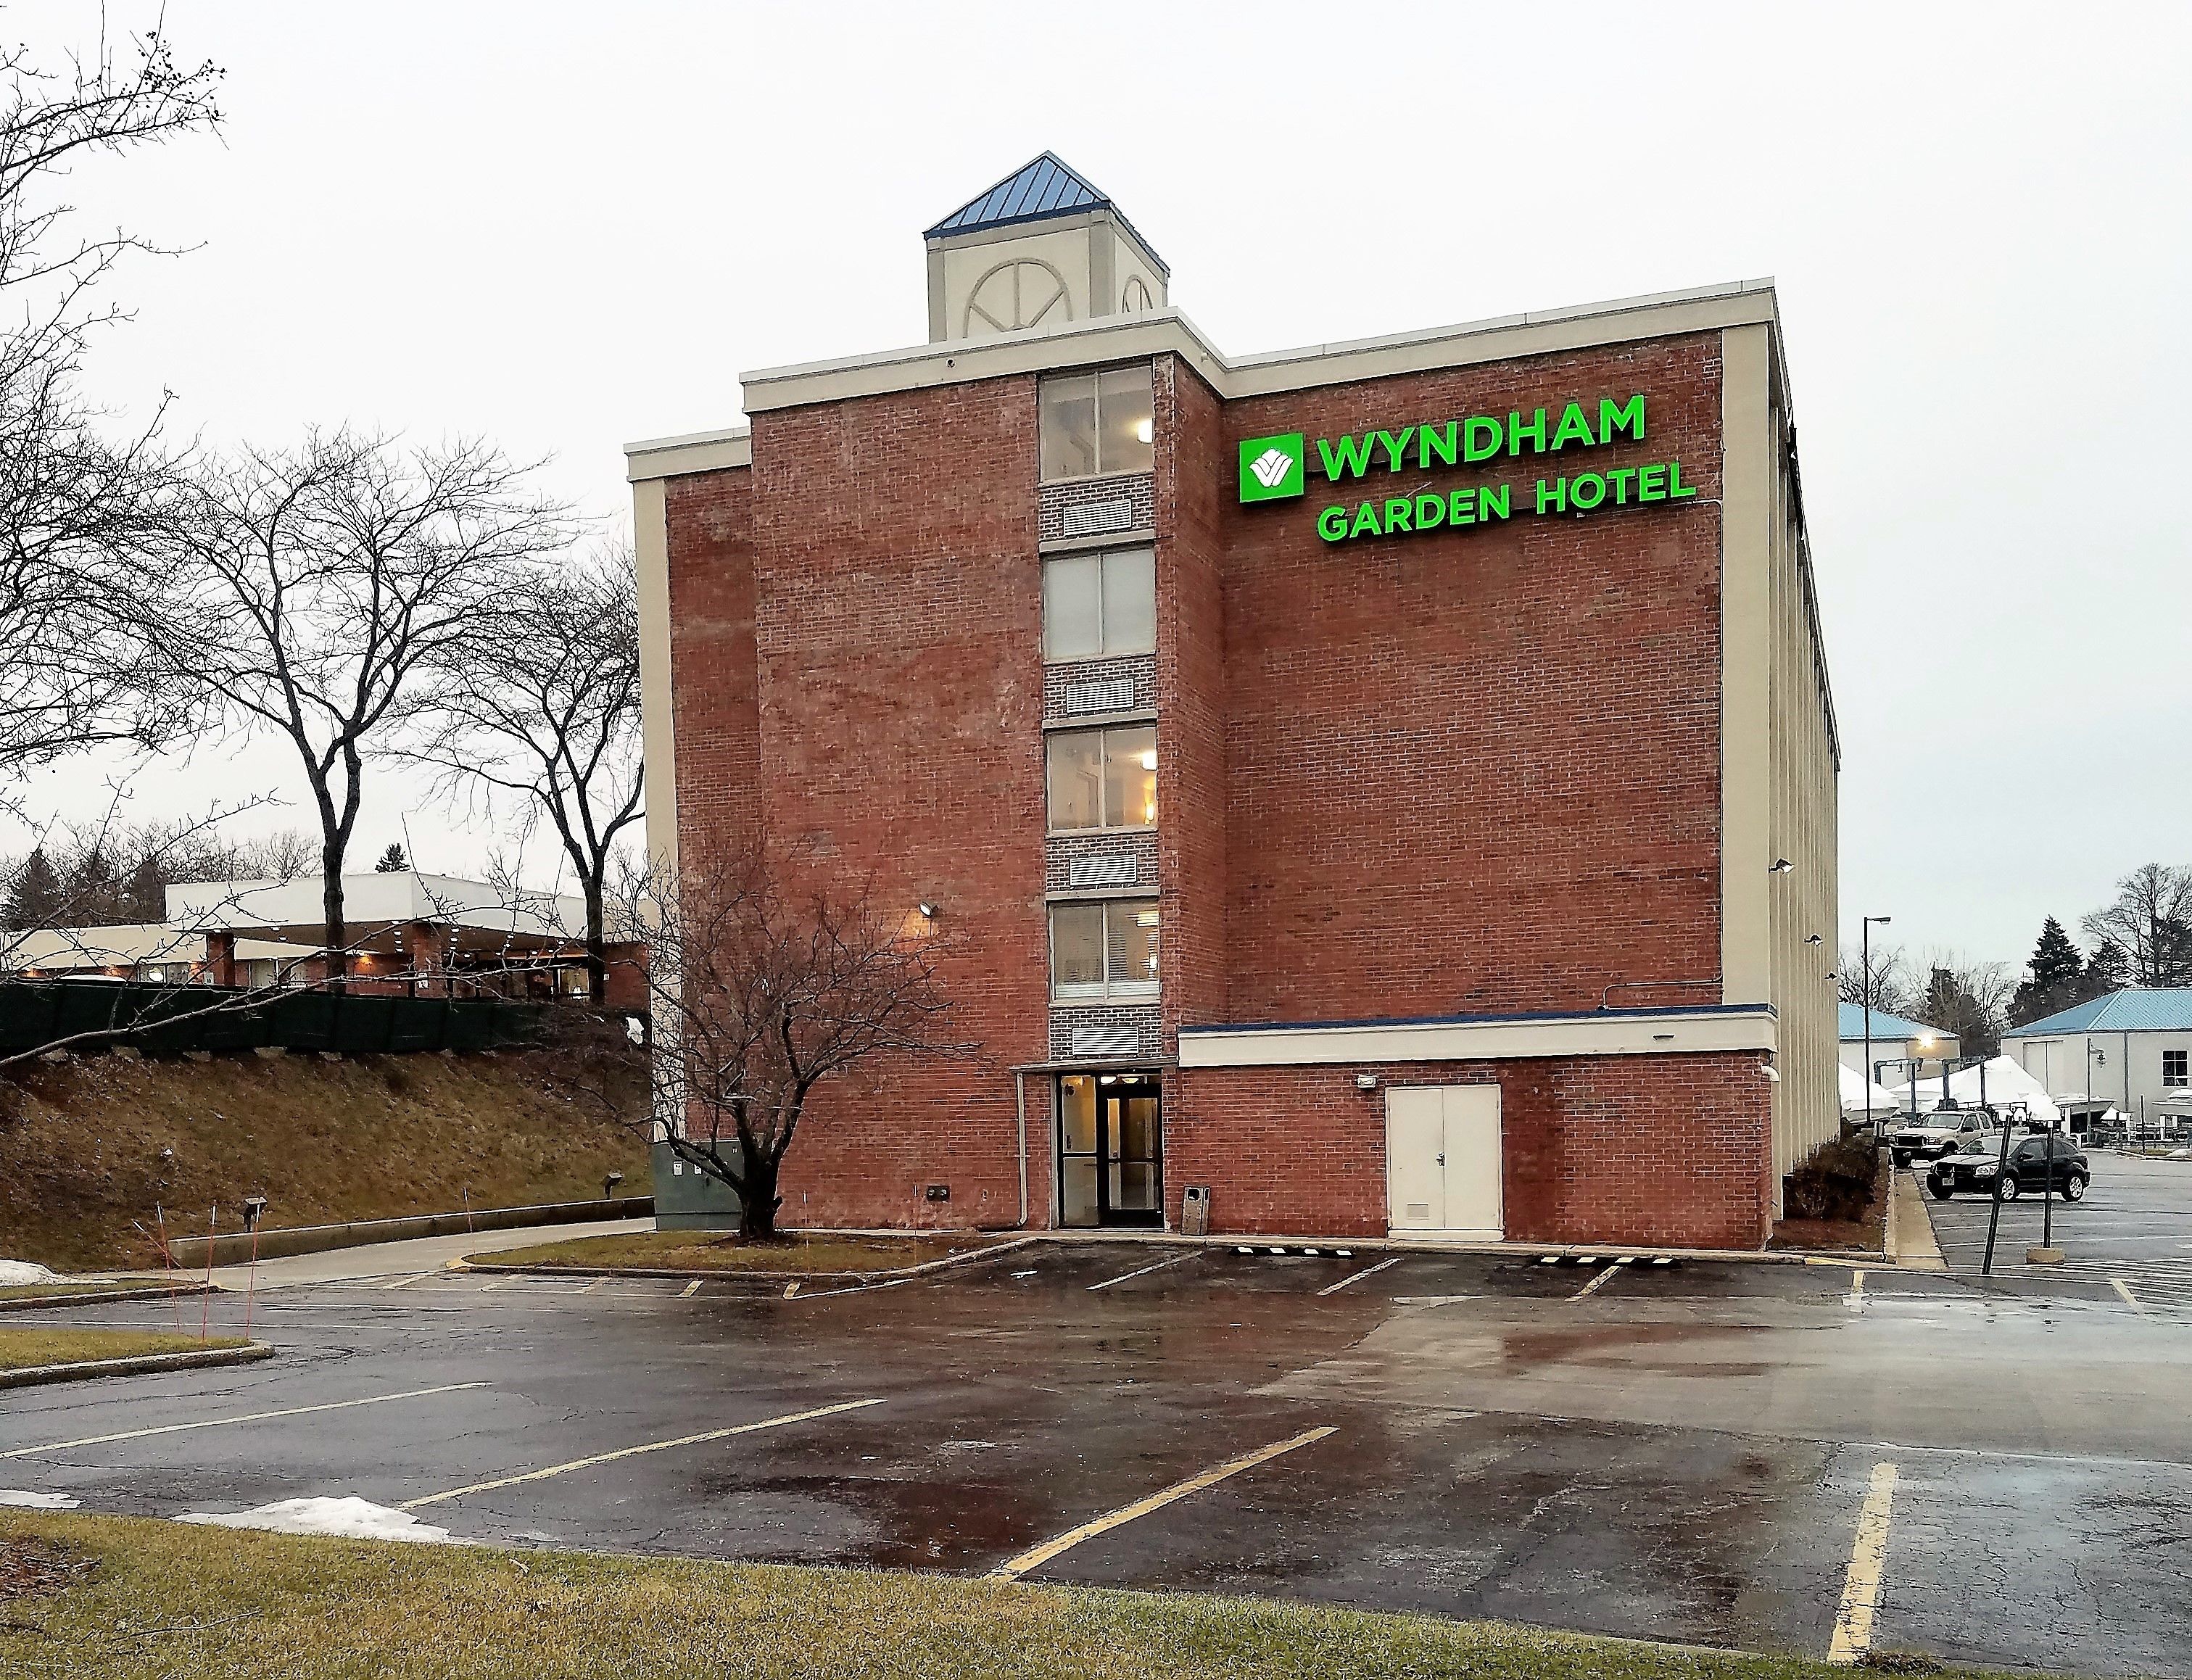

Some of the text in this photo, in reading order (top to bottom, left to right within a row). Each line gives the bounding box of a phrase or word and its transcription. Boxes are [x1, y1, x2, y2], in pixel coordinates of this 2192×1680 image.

[1318, 395, 1645, 481] WYNDHAM
[1317, 461, 1697, 542] GARDEN HOTEL
